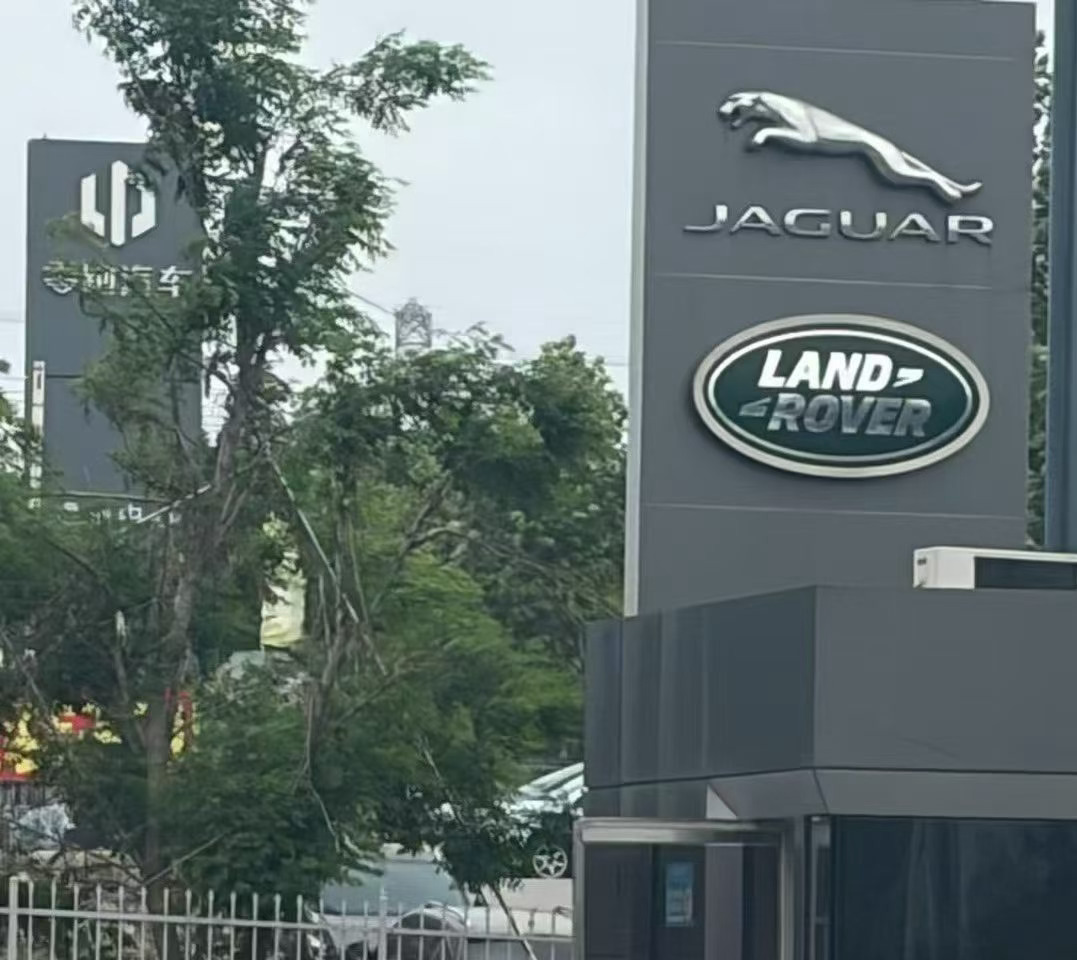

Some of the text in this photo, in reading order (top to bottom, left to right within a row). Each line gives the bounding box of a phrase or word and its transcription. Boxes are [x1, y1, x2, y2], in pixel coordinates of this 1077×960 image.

[683, 205, 994, 246] JAGUAR
[757, 349, 893, 392] LAND
[767, 393, 932, 437] ROVER
